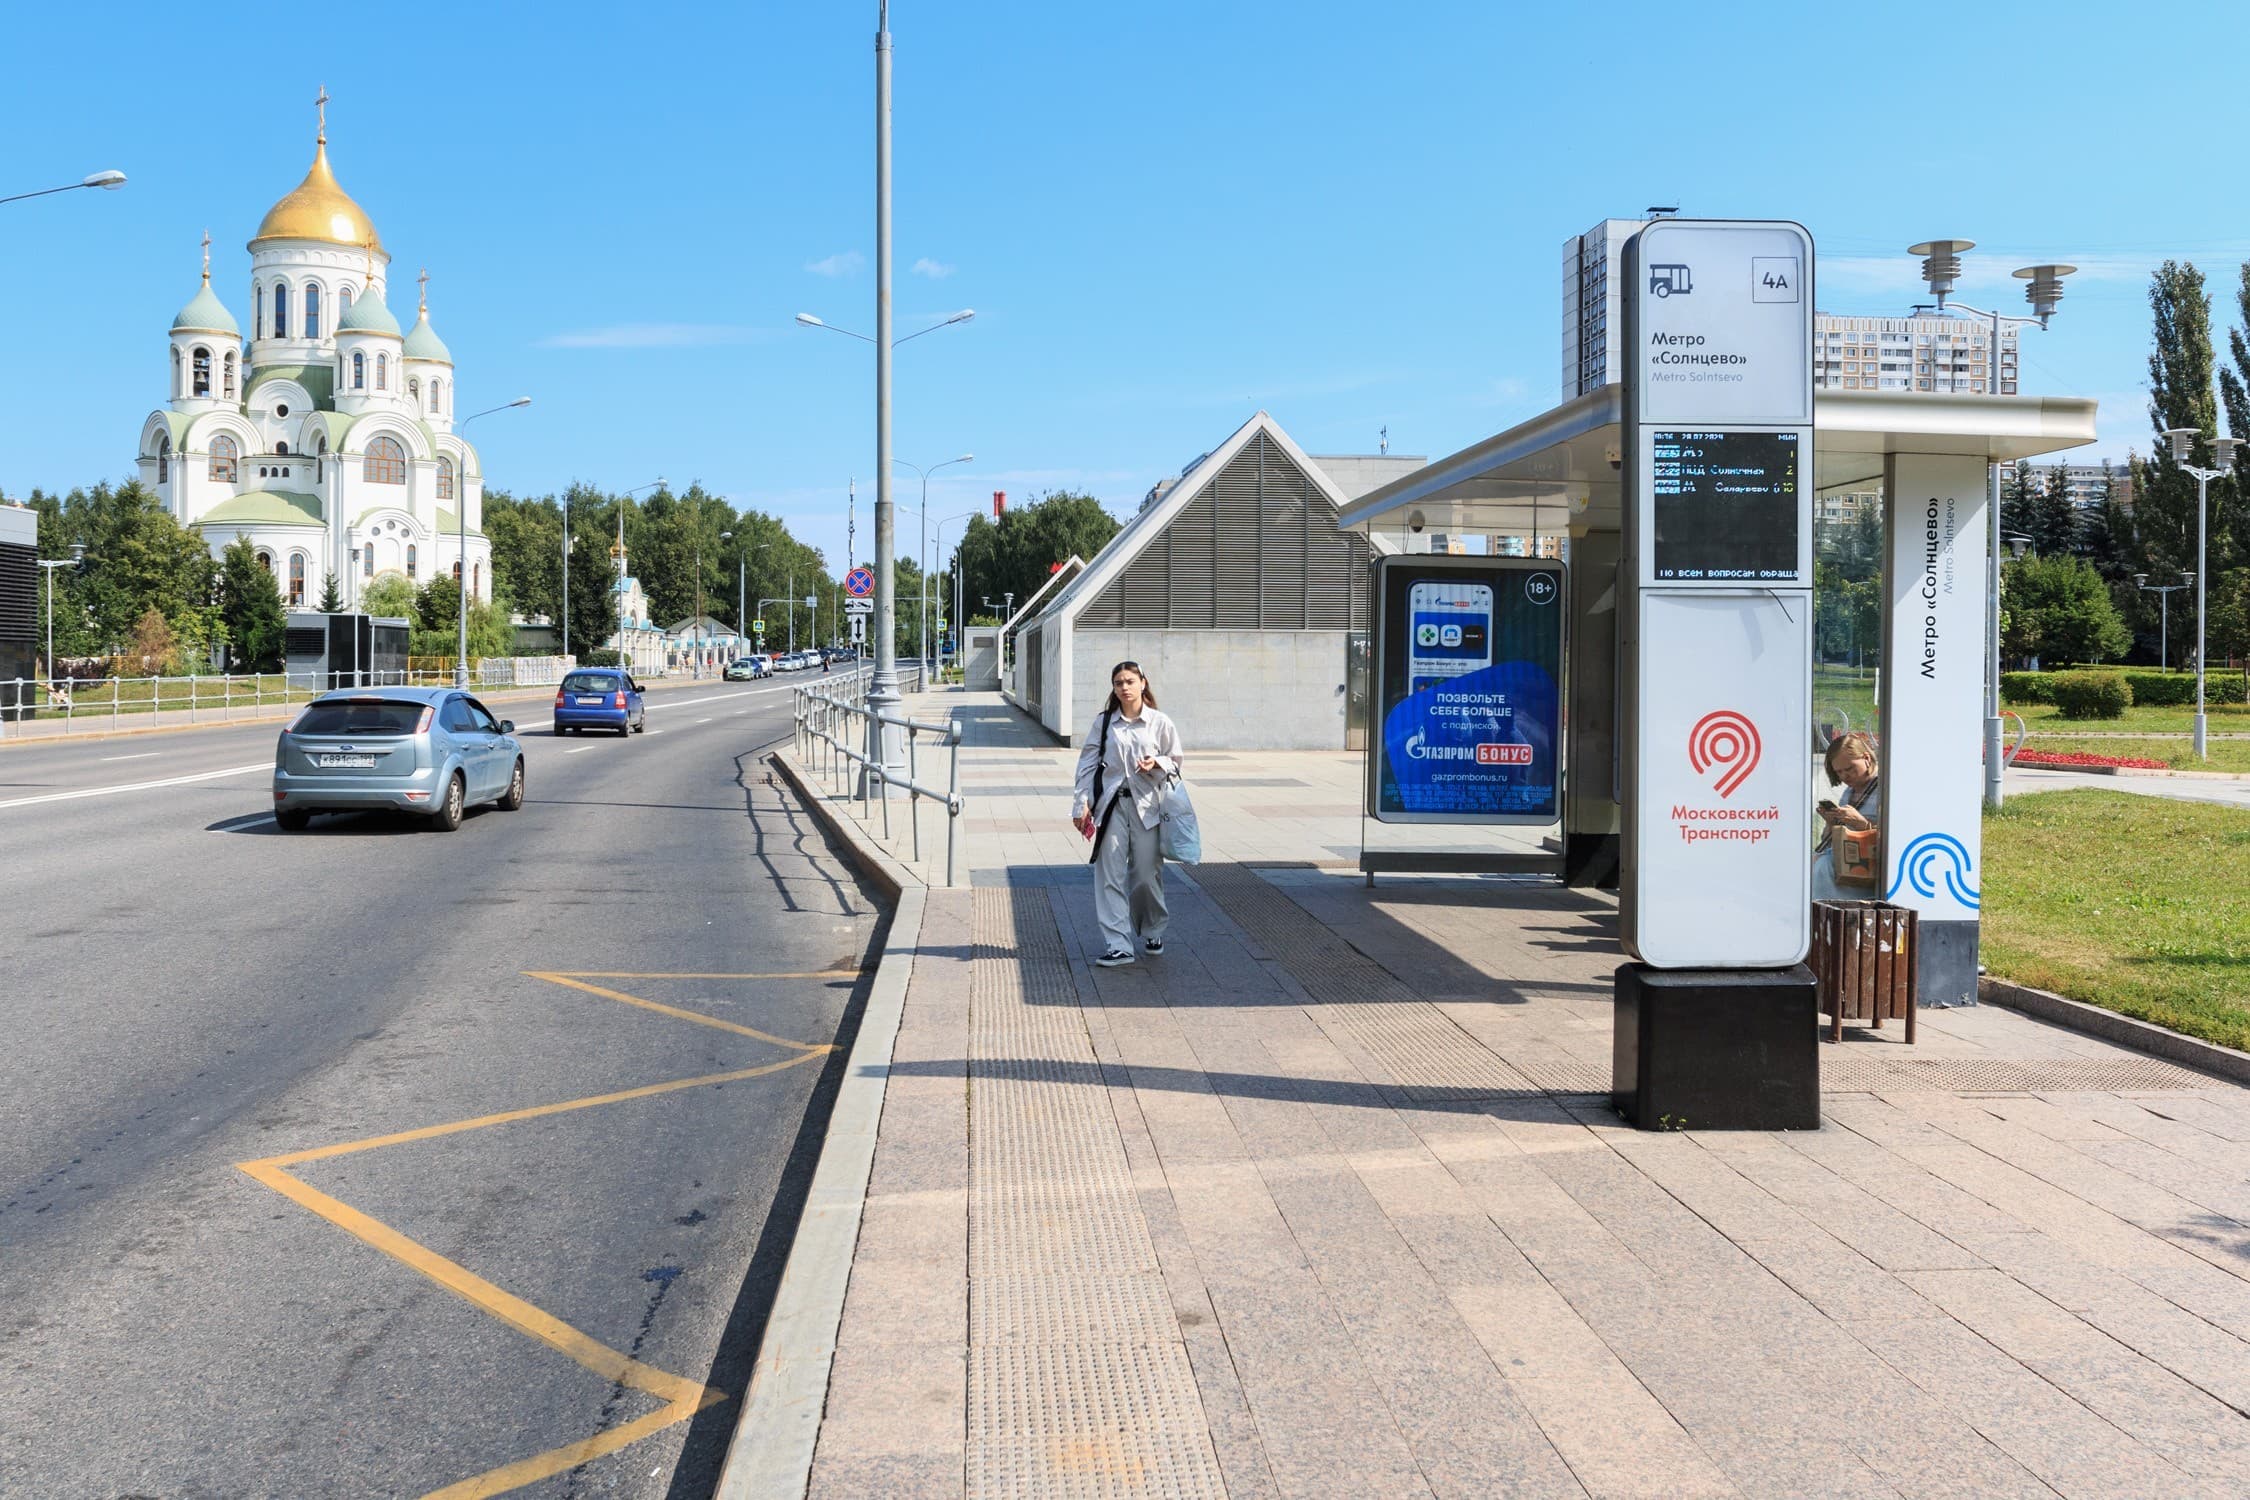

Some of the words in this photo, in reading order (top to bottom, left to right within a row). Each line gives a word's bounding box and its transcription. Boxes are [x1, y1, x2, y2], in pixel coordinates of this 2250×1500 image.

[1762, 271, 1788, 289] 4А
[1651, 332, 1705, 348] Метро
[1651, 351, 1747, 366] «Солнцево»
[1651, 372, 1687, 383] Metro
[1689, 372, 1743, 383] Solntsevo
[1943, 497, 1955, 553] Solntsevo
[1922, 497, 1940, 610] «Солнцево»
[1943, 555, 1954, 595] Metro
[1529, 581, 1552, 595] 18+
[1921, 615, 1940, 679] Метро
[1437, 693, 1505, 704] ПОЗВОЛЬТЕ
[1430, 706, 1460, 716] СЕБЕ
[1462, 706, 1512, 717] БОЛЬШЕ
[1427, 747, 1474, 760] ГАЗПРОМ
[1480, 747, 1530, 762] БОНУС
[1431, 773, 1508, 783] gazprombonus.ru
[1671, 805, 1779, 820] Московский
[1679, 825, 1770, 843] Транспорт
